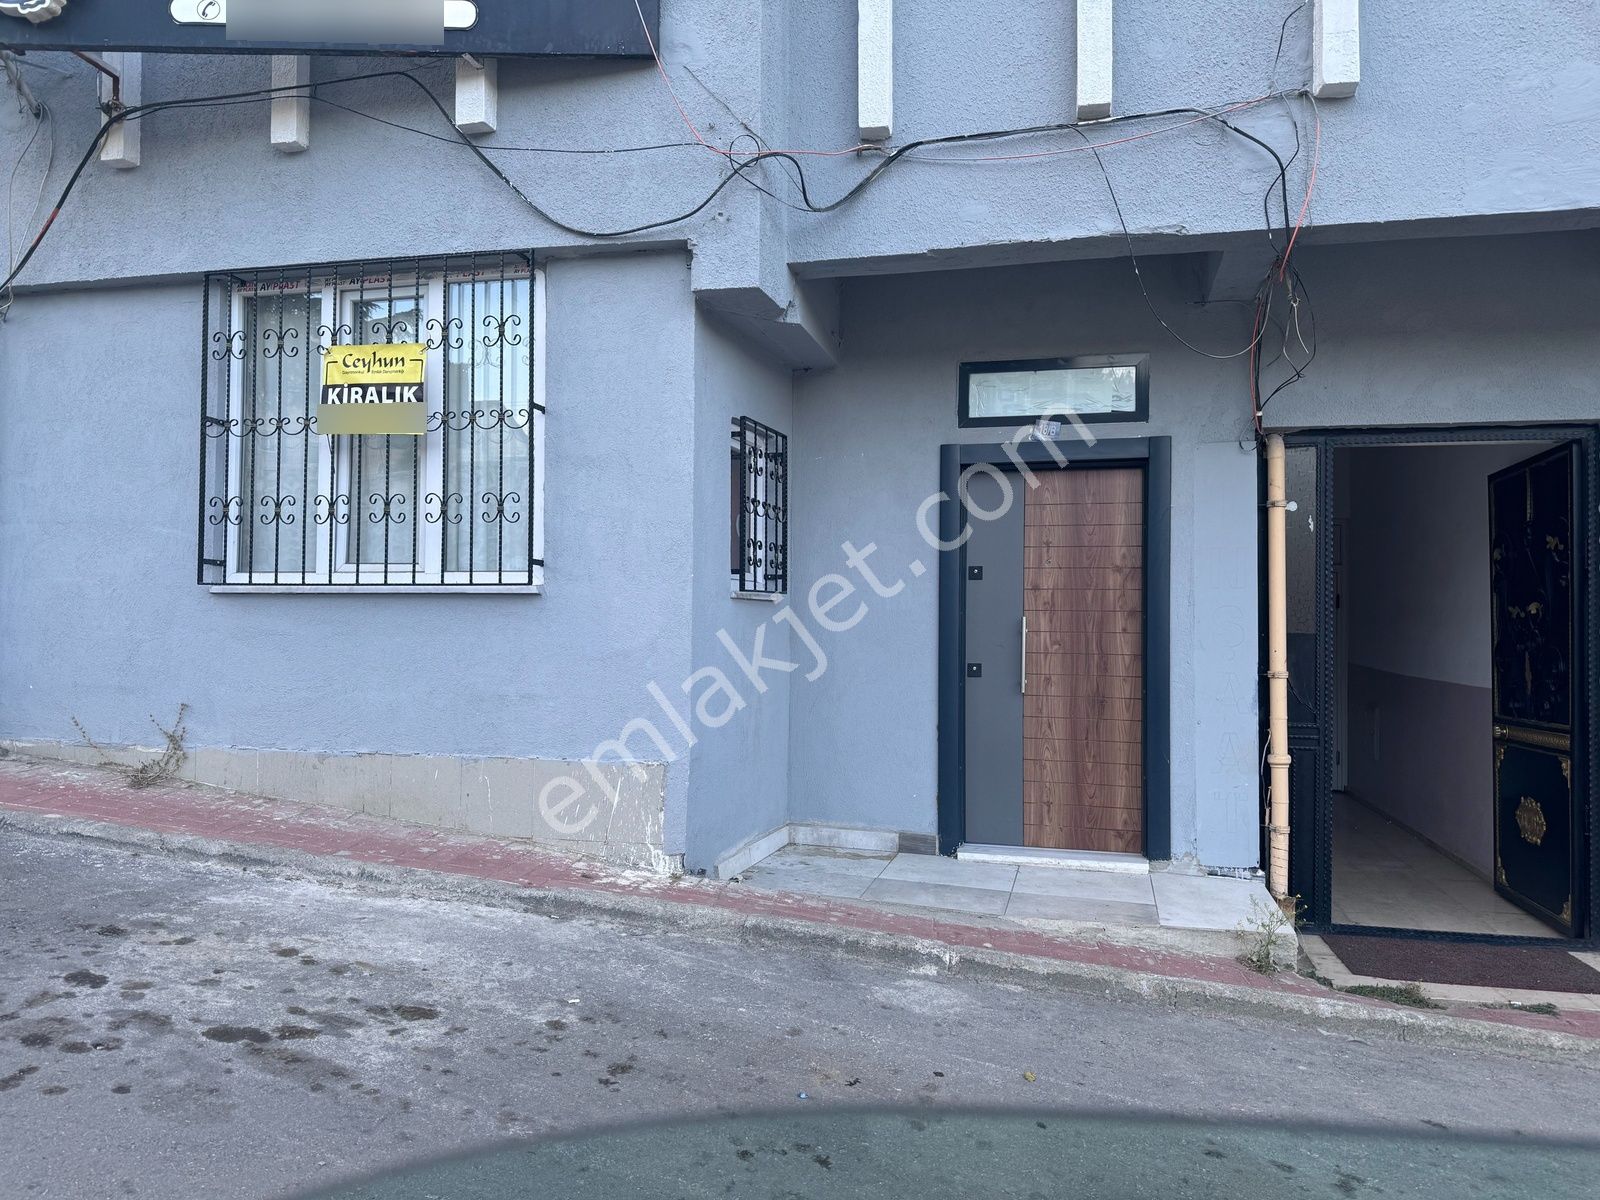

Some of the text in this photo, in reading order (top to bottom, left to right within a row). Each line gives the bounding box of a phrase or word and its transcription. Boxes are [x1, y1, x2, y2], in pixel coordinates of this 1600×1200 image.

[260, 282, 271, 291] AY
[342, 351, 405, 373] Ceyhun
[327, 382, 419, 405] KİRALIK
